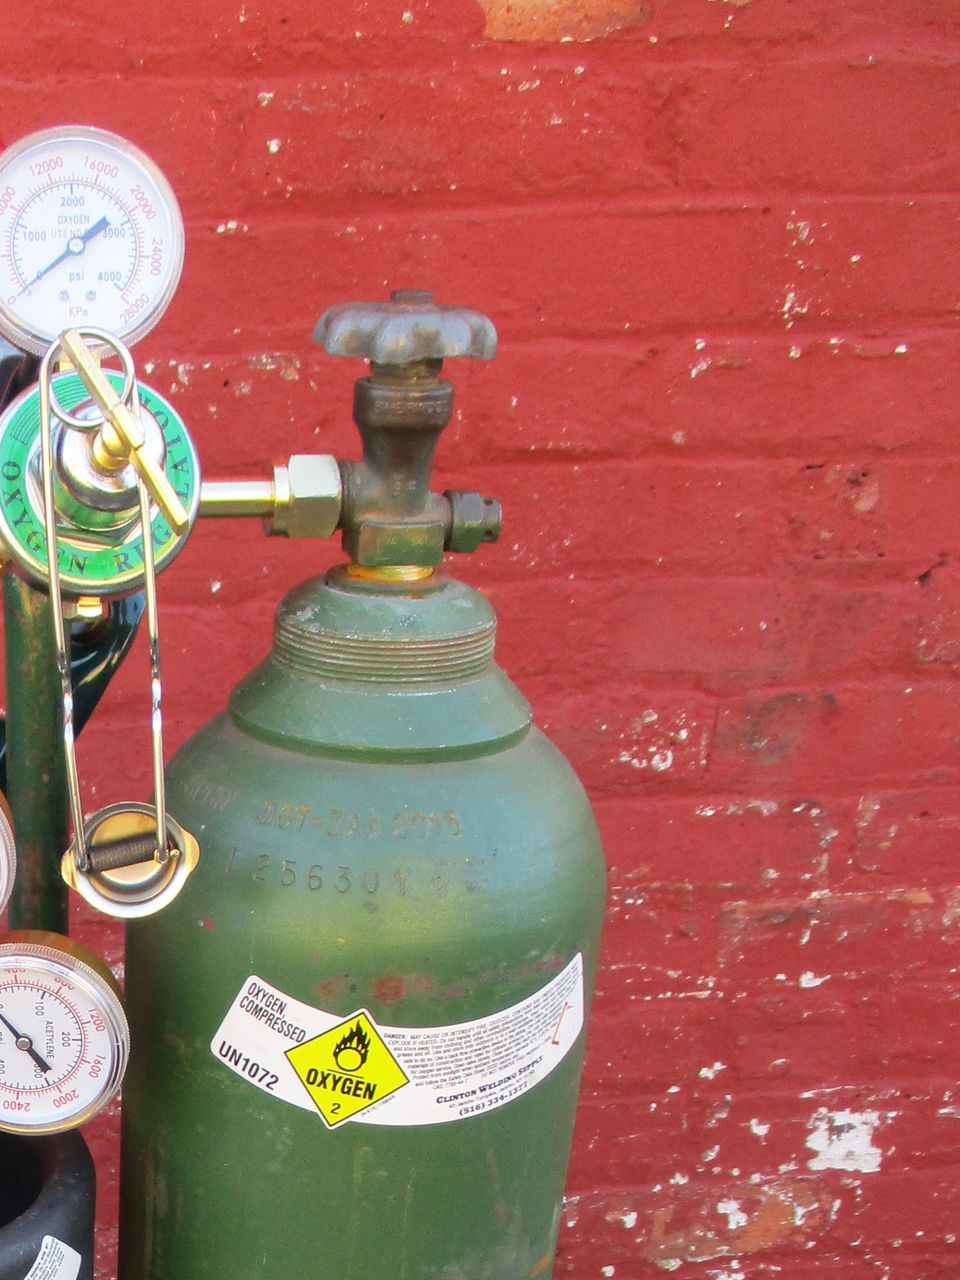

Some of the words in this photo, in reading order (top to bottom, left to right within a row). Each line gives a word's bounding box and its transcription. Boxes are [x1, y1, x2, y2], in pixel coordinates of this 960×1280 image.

[29, 156, 64, 177] 12000
[83, 156, 119, 178] 16000
[60, 196, 85, 207] 2000
[130, 185, 157, 221] 20000
[58, 215, 90, 225] OXYGEN
[23, 230, 46, 241] 1000
[102, 227, 126, 239] 3000
[150, 238, 164, 276] 24000
[69, 271, 85, 283] psi
[97, 271, 122, 282] 4000
[69, 306, 88, 317] KPa
[119, 293, 150, 324] 28000
[34, 1001, 44, 1016] 100
[247, 981, 288, 1018] OXYGEN,
[88, 1008, 106, 1032] 1200
[239, 995, 307, 1043] COMPRESSED
[45, 1020, 55, 1059] ACETYLENE
[60, 1031, 71, 1048] 200
[88, 1055, 106, 1079] 1600
[218, 1040, 280, 1091] UN1072
[305, 1068, 377, 1101] OXYGEN
[436, 1089, 477, 1104] CLINTON
[478, 1072, 517, 1093] WELDING
[2, 1100, 30, 1112] 2400
[52, 1089, 80, 1109] 2000
[330, 1102, 341, 1115] 2
[459, 1101, 486, 1117] (516)
